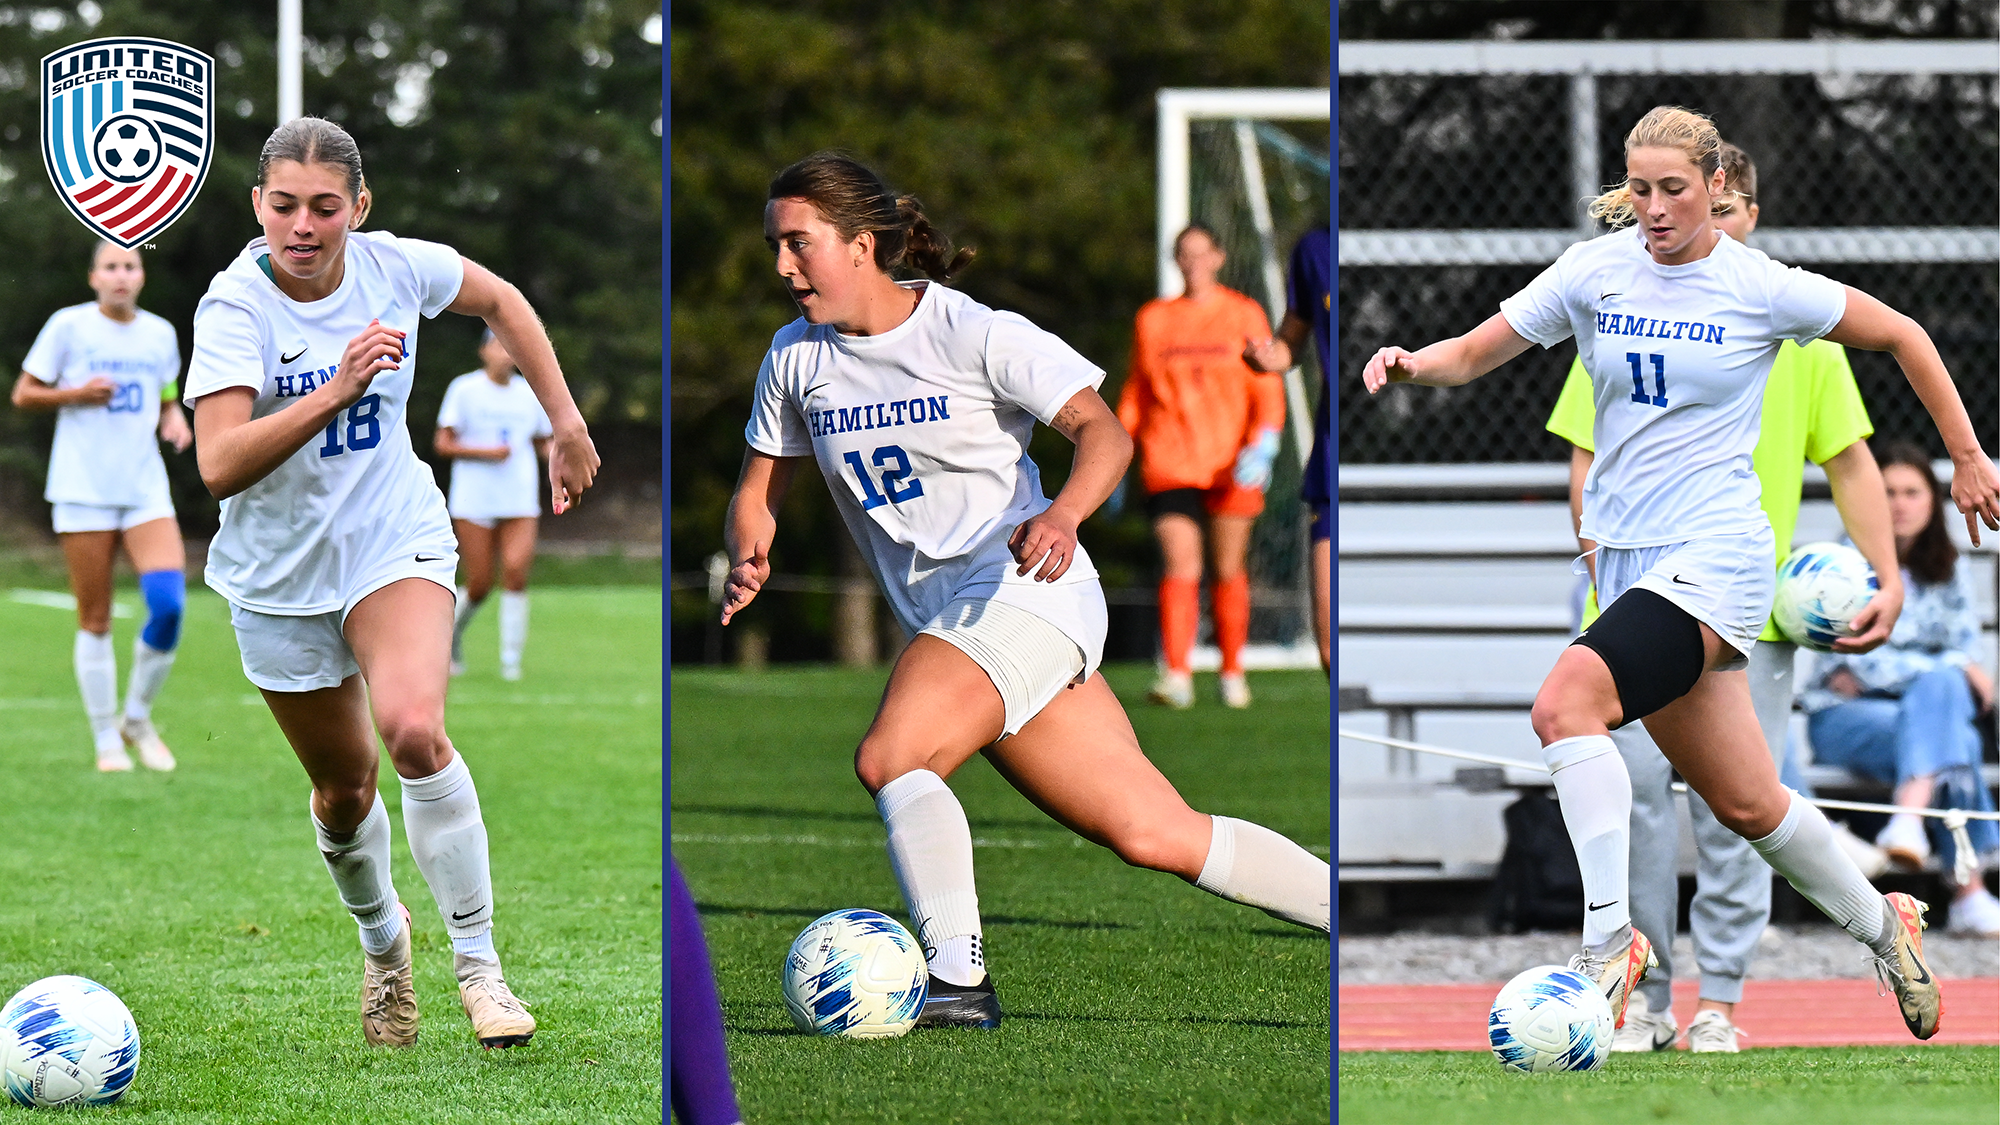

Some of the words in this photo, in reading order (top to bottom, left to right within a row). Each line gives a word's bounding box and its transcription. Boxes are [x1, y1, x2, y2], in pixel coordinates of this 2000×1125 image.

[1596, 311, 1726, 345] HAMILTON
[107, 381, 144, 412] 20
[1625, 352, 1669, 408] 11
[319, 392, 382, 458] 18
[809, 395, 950, 437] HAMILTON
[842, 444, 925, 511] 12
